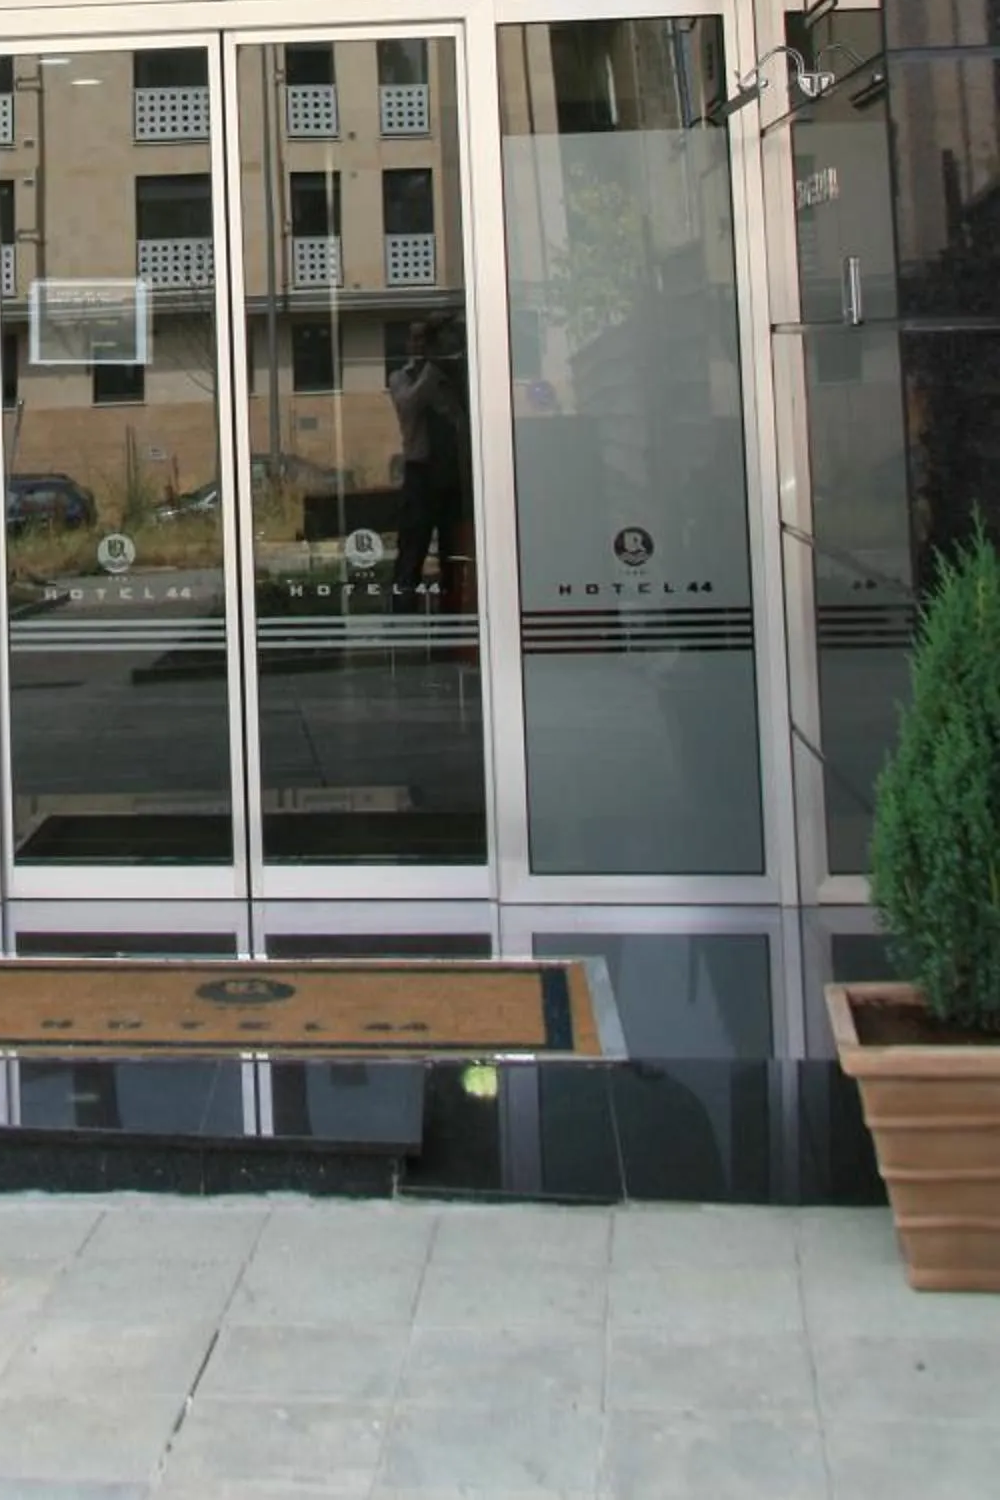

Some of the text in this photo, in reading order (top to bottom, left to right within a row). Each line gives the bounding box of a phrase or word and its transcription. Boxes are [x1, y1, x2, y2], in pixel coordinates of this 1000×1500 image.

[44, 587, 192, 600] HOTEL 44
[289, 583, 441, 597] HOTEL 44
[558, 581, 713, 596] HOTEL 44
